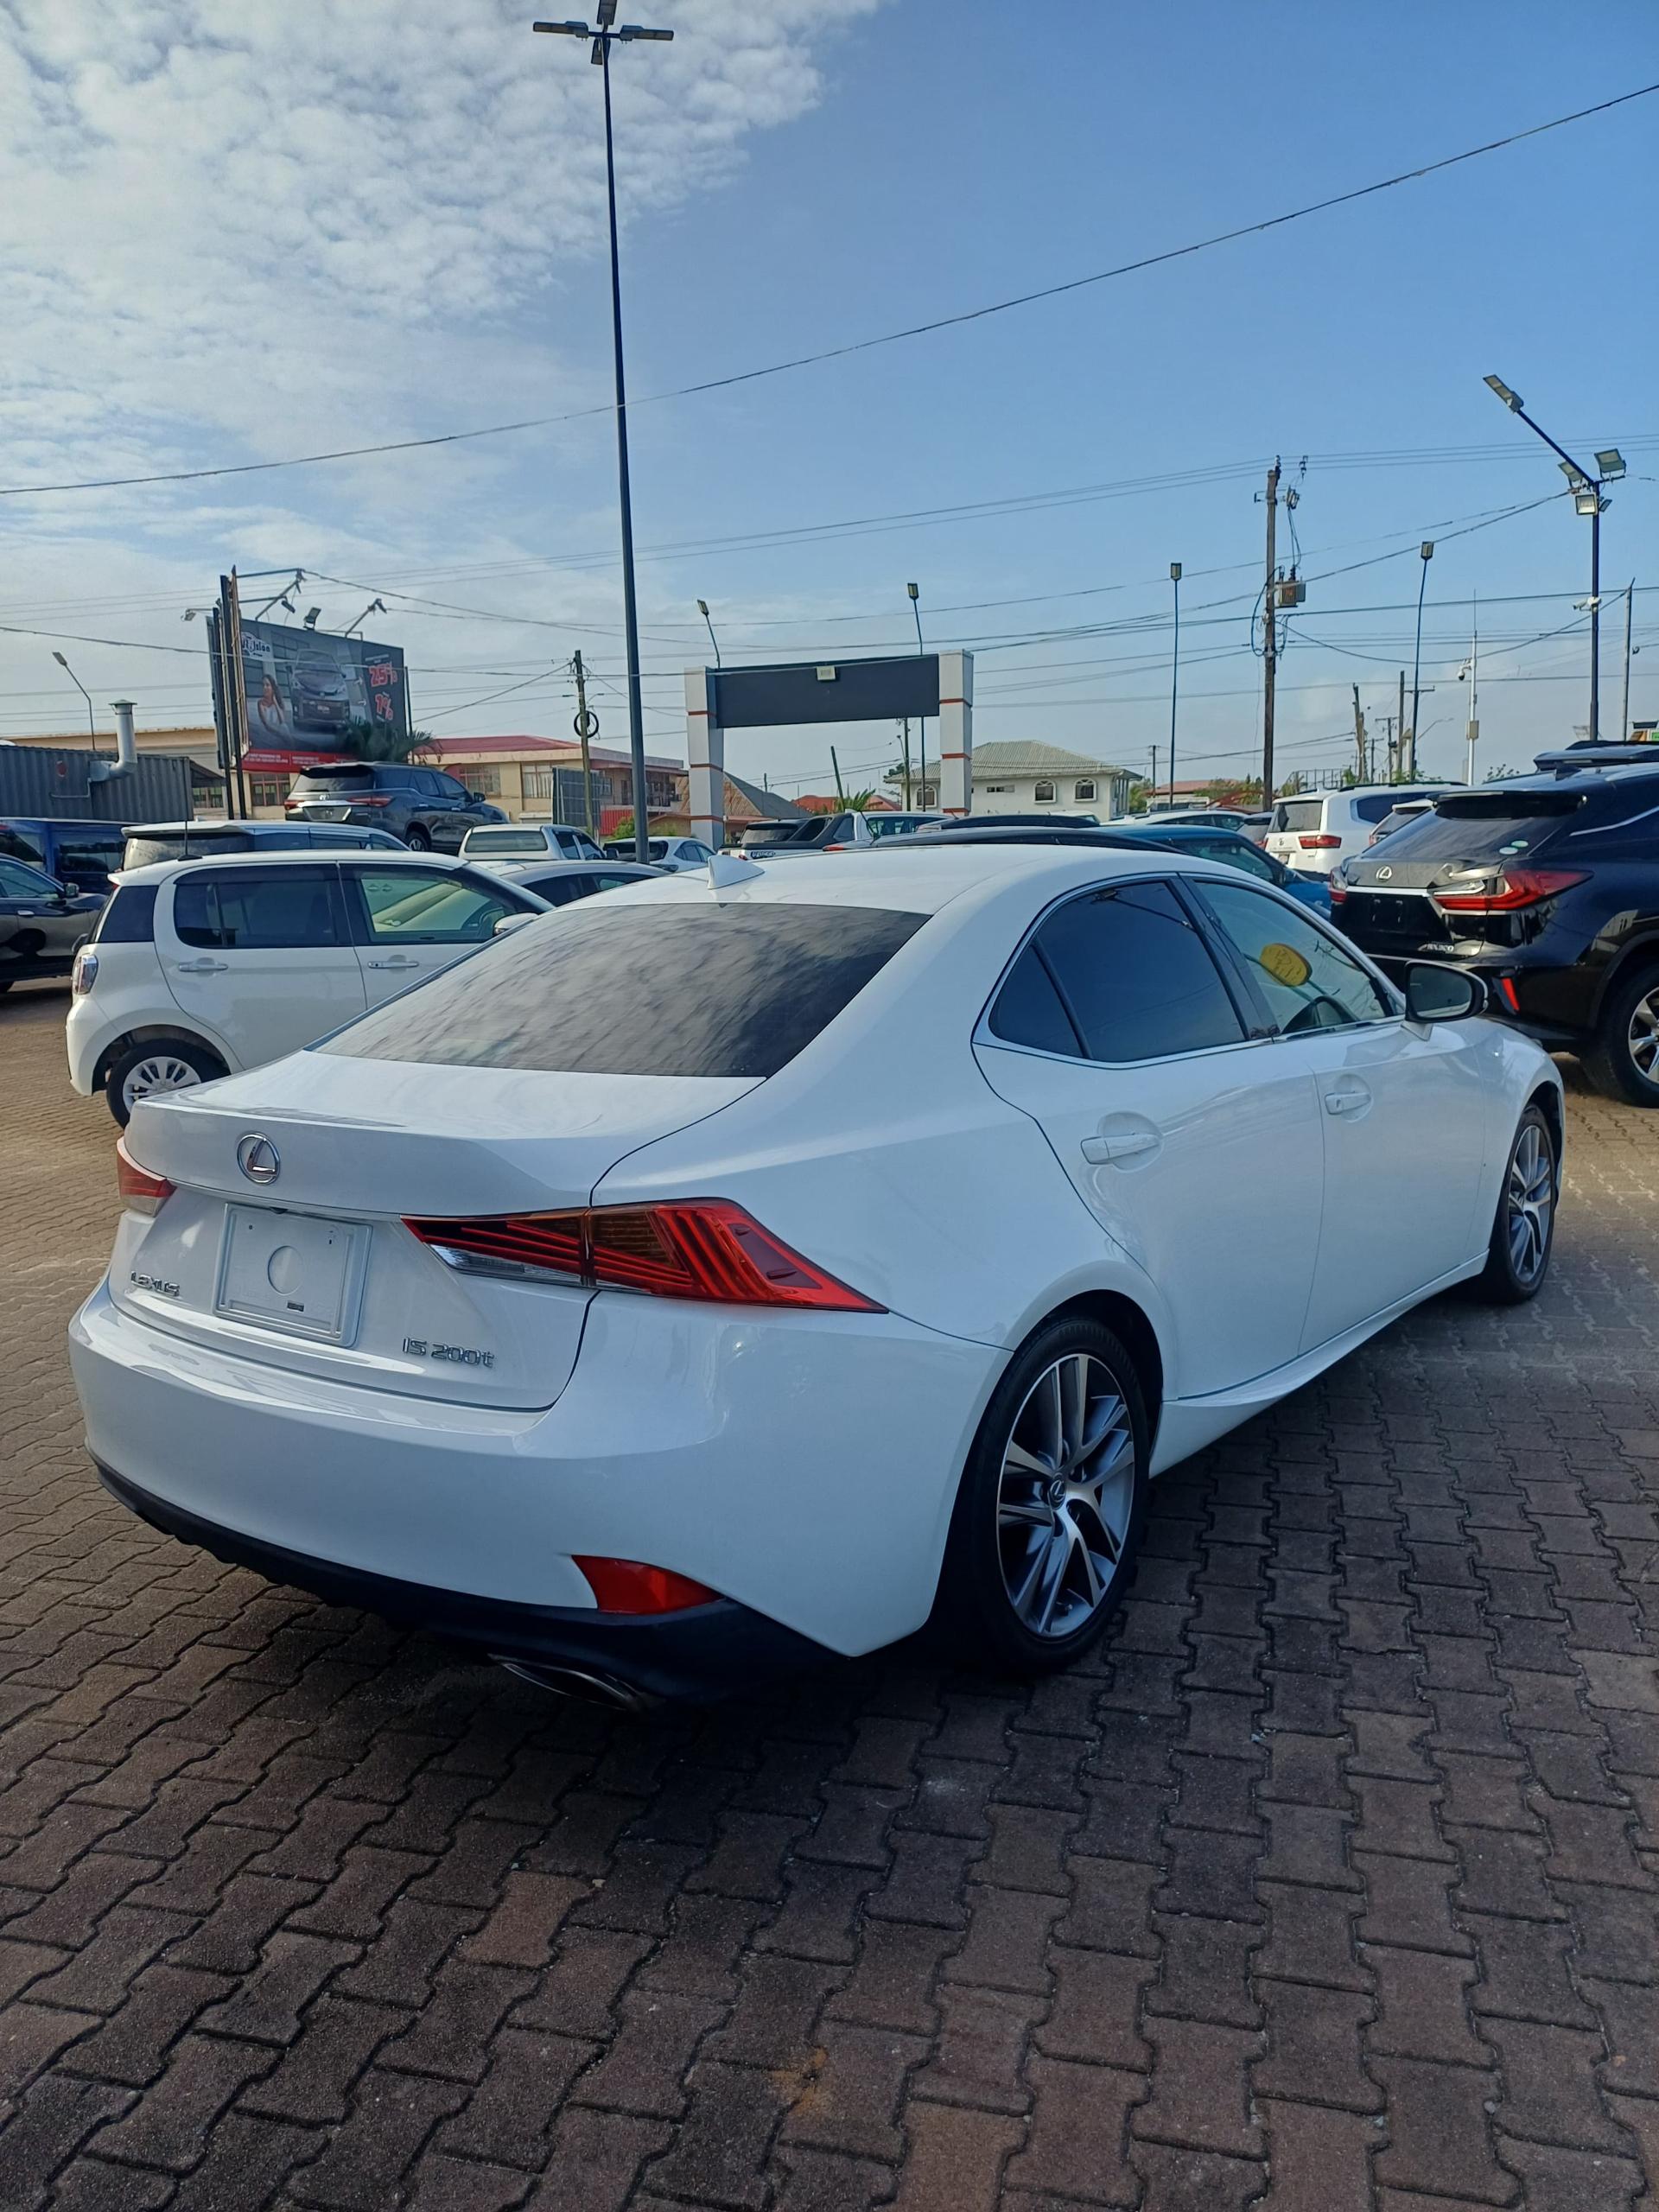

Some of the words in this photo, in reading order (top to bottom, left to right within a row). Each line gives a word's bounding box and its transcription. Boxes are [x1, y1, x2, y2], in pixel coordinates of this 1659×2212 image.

[130, 1271, 181, 1297] LEXUS
[403, 1338, 428, 1357] IS
[431, 1343, 495, 1368] 200t
